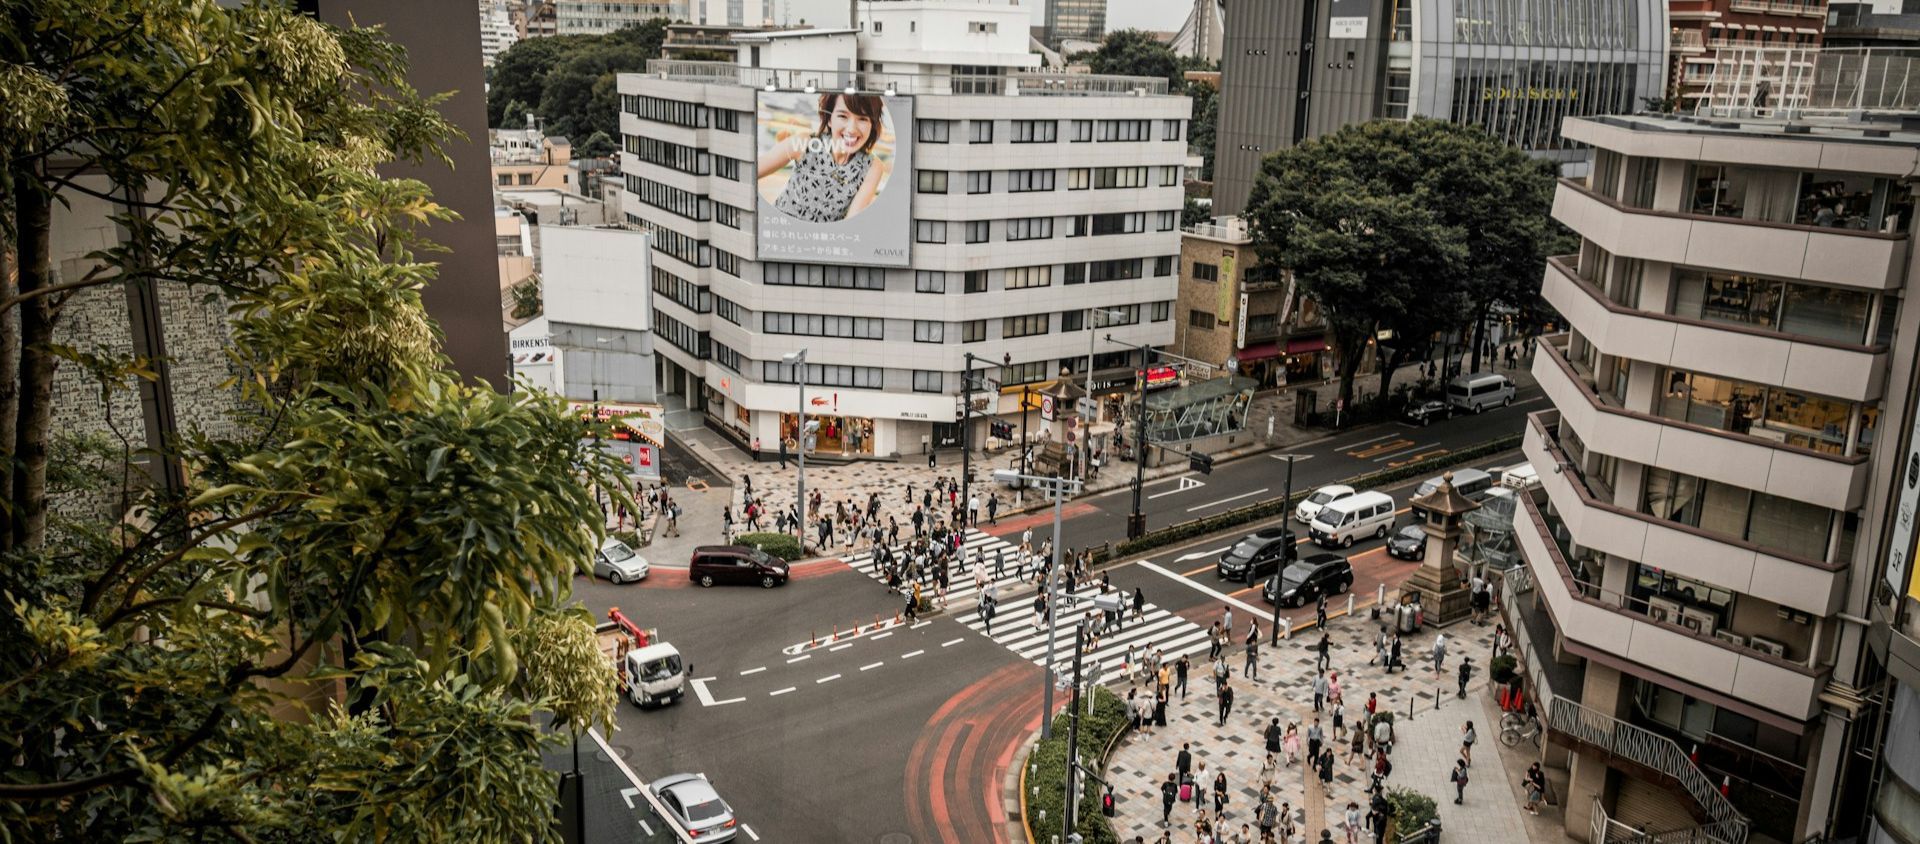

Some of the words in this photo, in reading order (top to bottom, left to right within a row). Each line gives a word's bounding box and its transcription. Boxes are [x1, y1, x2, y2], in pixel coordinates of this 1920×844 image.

[791, 136, 846, 154] WOW!
[873, 247, 905, 257] ACUVUE
[512, 338, 550, 349] BIRKENST
